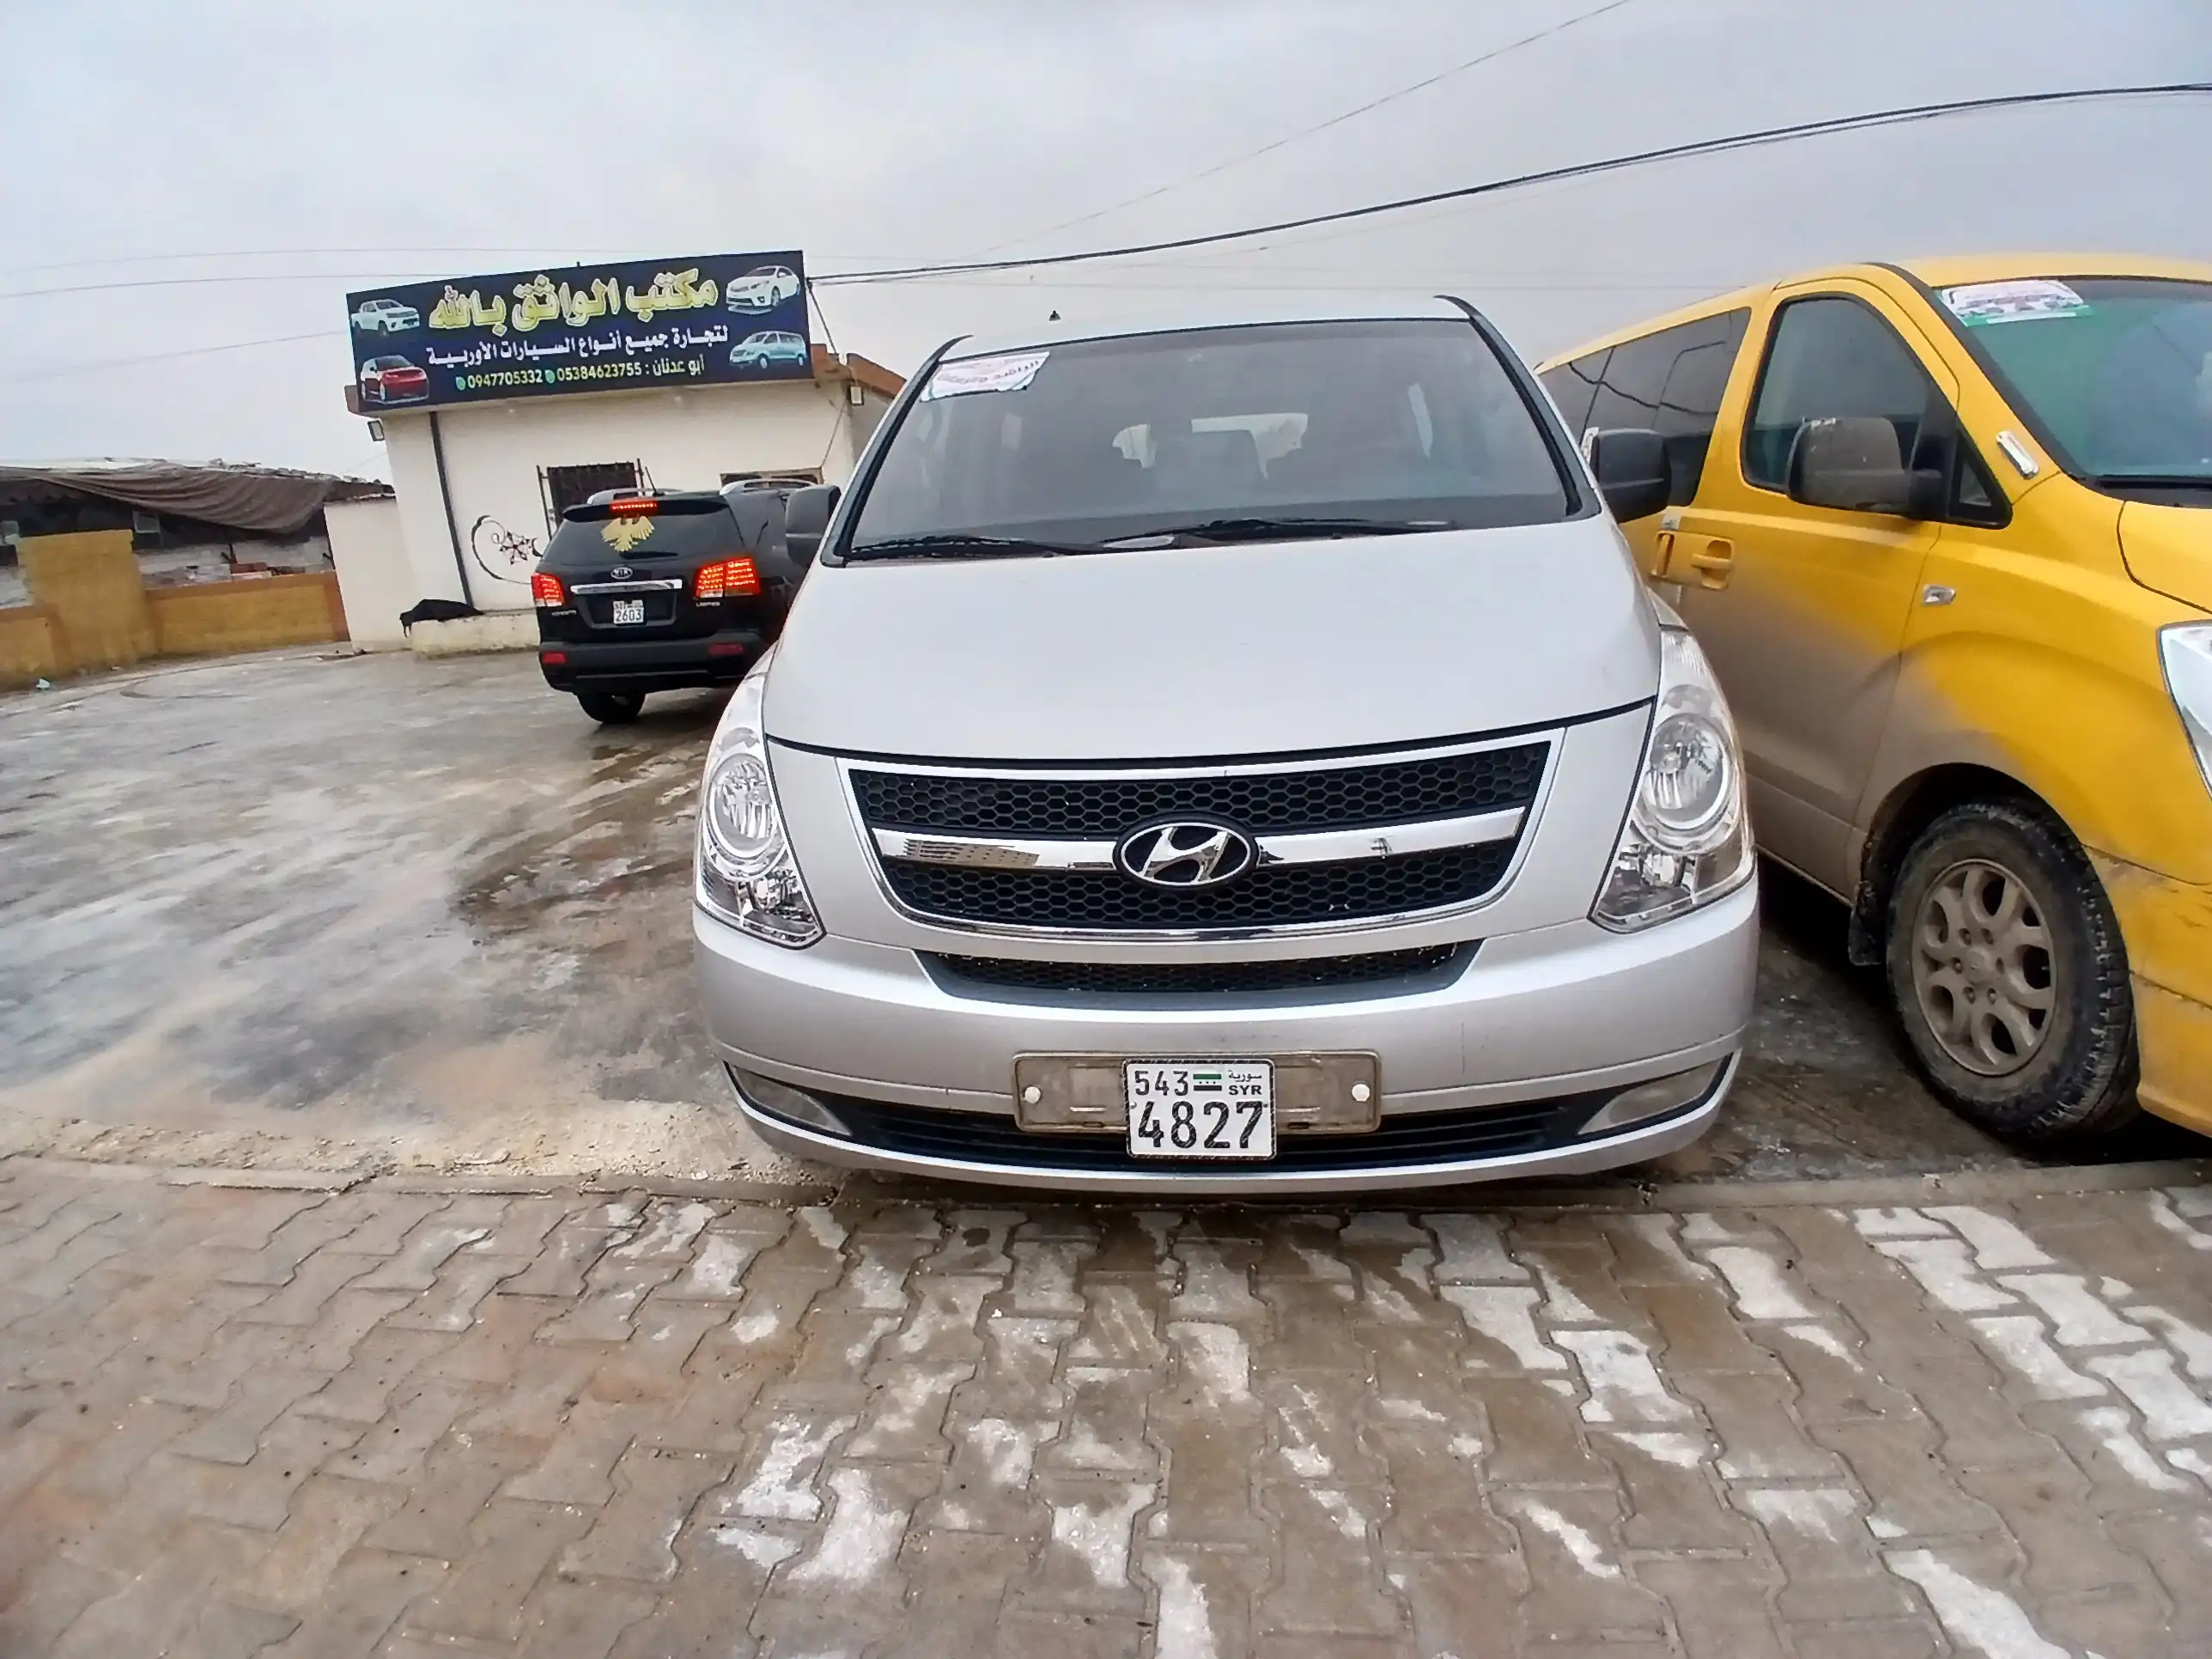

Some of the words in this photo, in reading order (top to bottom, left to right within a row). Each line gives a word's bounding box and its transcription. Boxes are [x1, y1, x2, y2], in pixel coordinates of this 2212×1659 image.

[512, 273, 621, 332] الواثق
[625, 267, 718, 323] مكتب
[428, 284, 507, 337] بالله
[625, 332, 669, 356] جميع
[672, 324, 729, 349] لتجارة
[500, 336, 576, 362] السيارات
[467, 368, 544, 389] 0947705332
[556, 362, 643, 383] 05384623755
[652, 356, 686, 377] عدنان
[611, 567, 633, 579] KIA
[616, 608, 642, 622] 2603
[1134, 1070, 1189, 1097] 543
[1228, 1070, 1262, 1083] سورية
[1228, 1085, 1262, 1096] SYR
[1138, 1101, 1263, 1149] 4827
